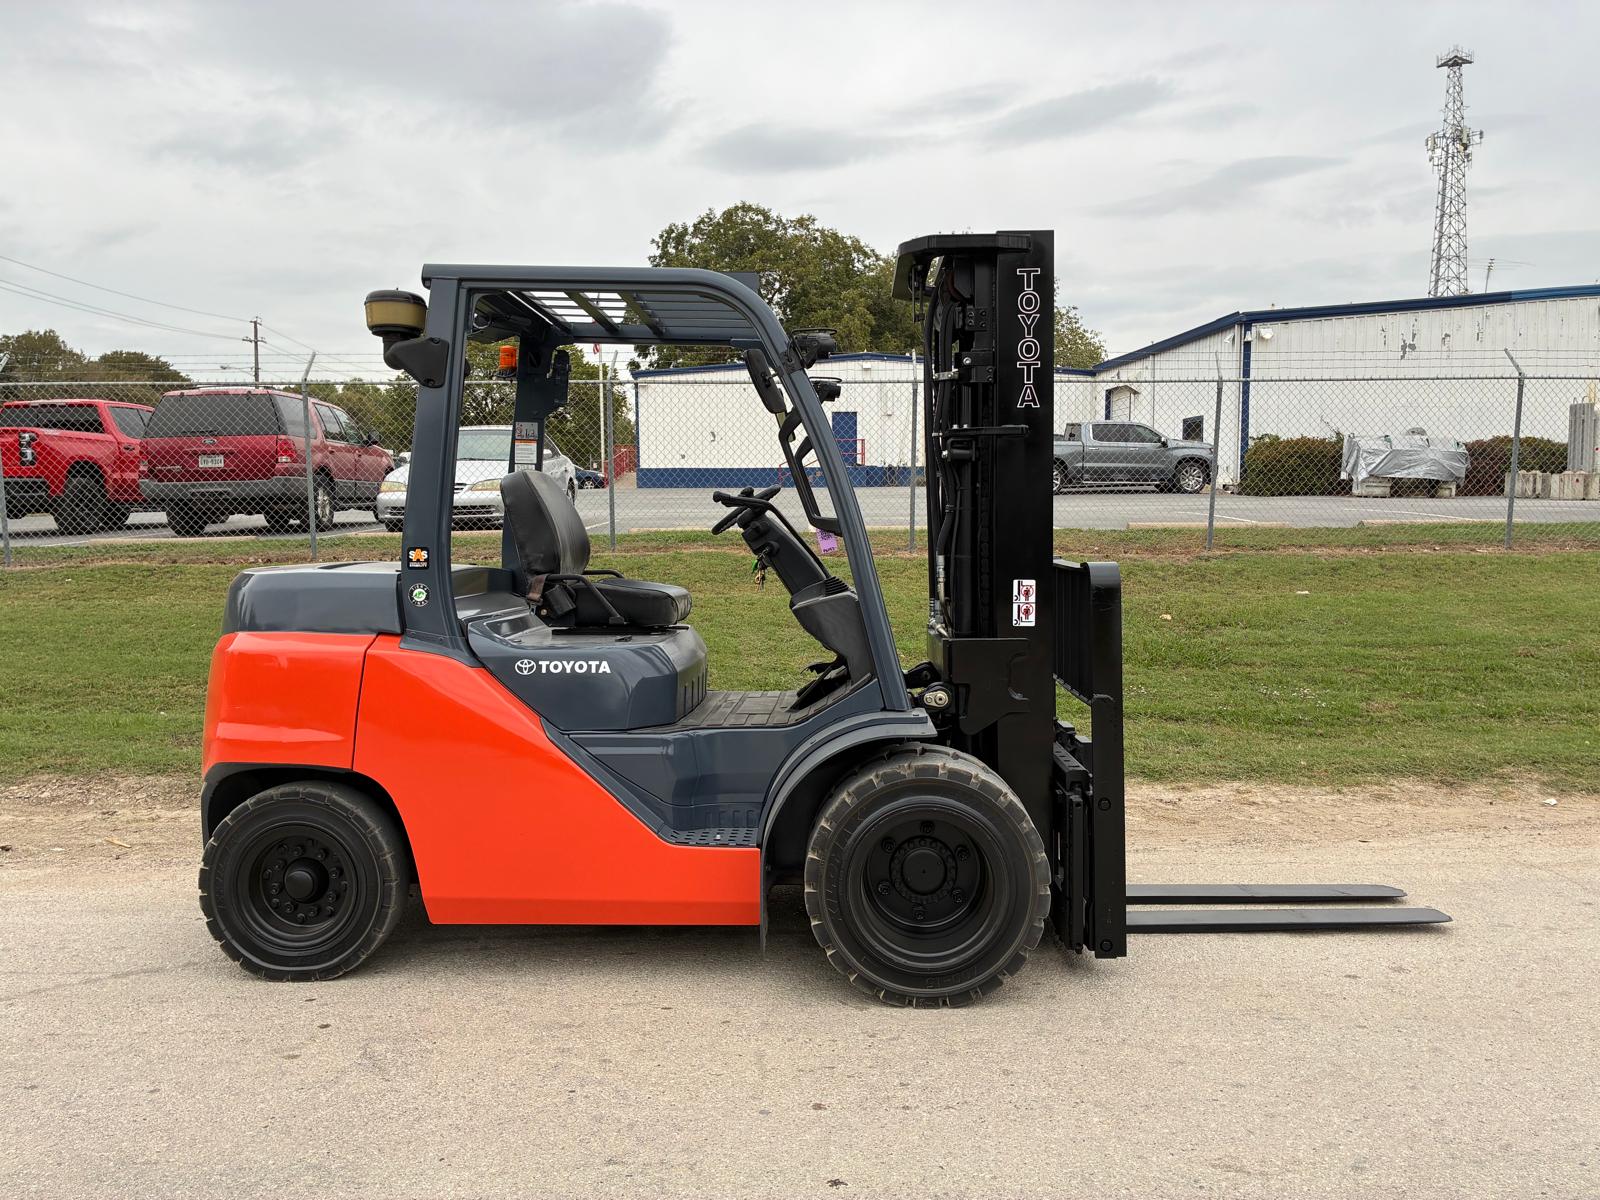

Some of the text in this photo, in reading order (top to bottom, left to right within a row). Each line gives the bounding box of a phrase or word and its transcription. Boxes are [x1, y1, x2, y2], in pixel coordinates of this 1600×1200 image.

[1017, 268, 1040, 408] TOYOTA
[408, 549, 428, 562] SAS
[539, 661, 611, 673] TOYOTA
